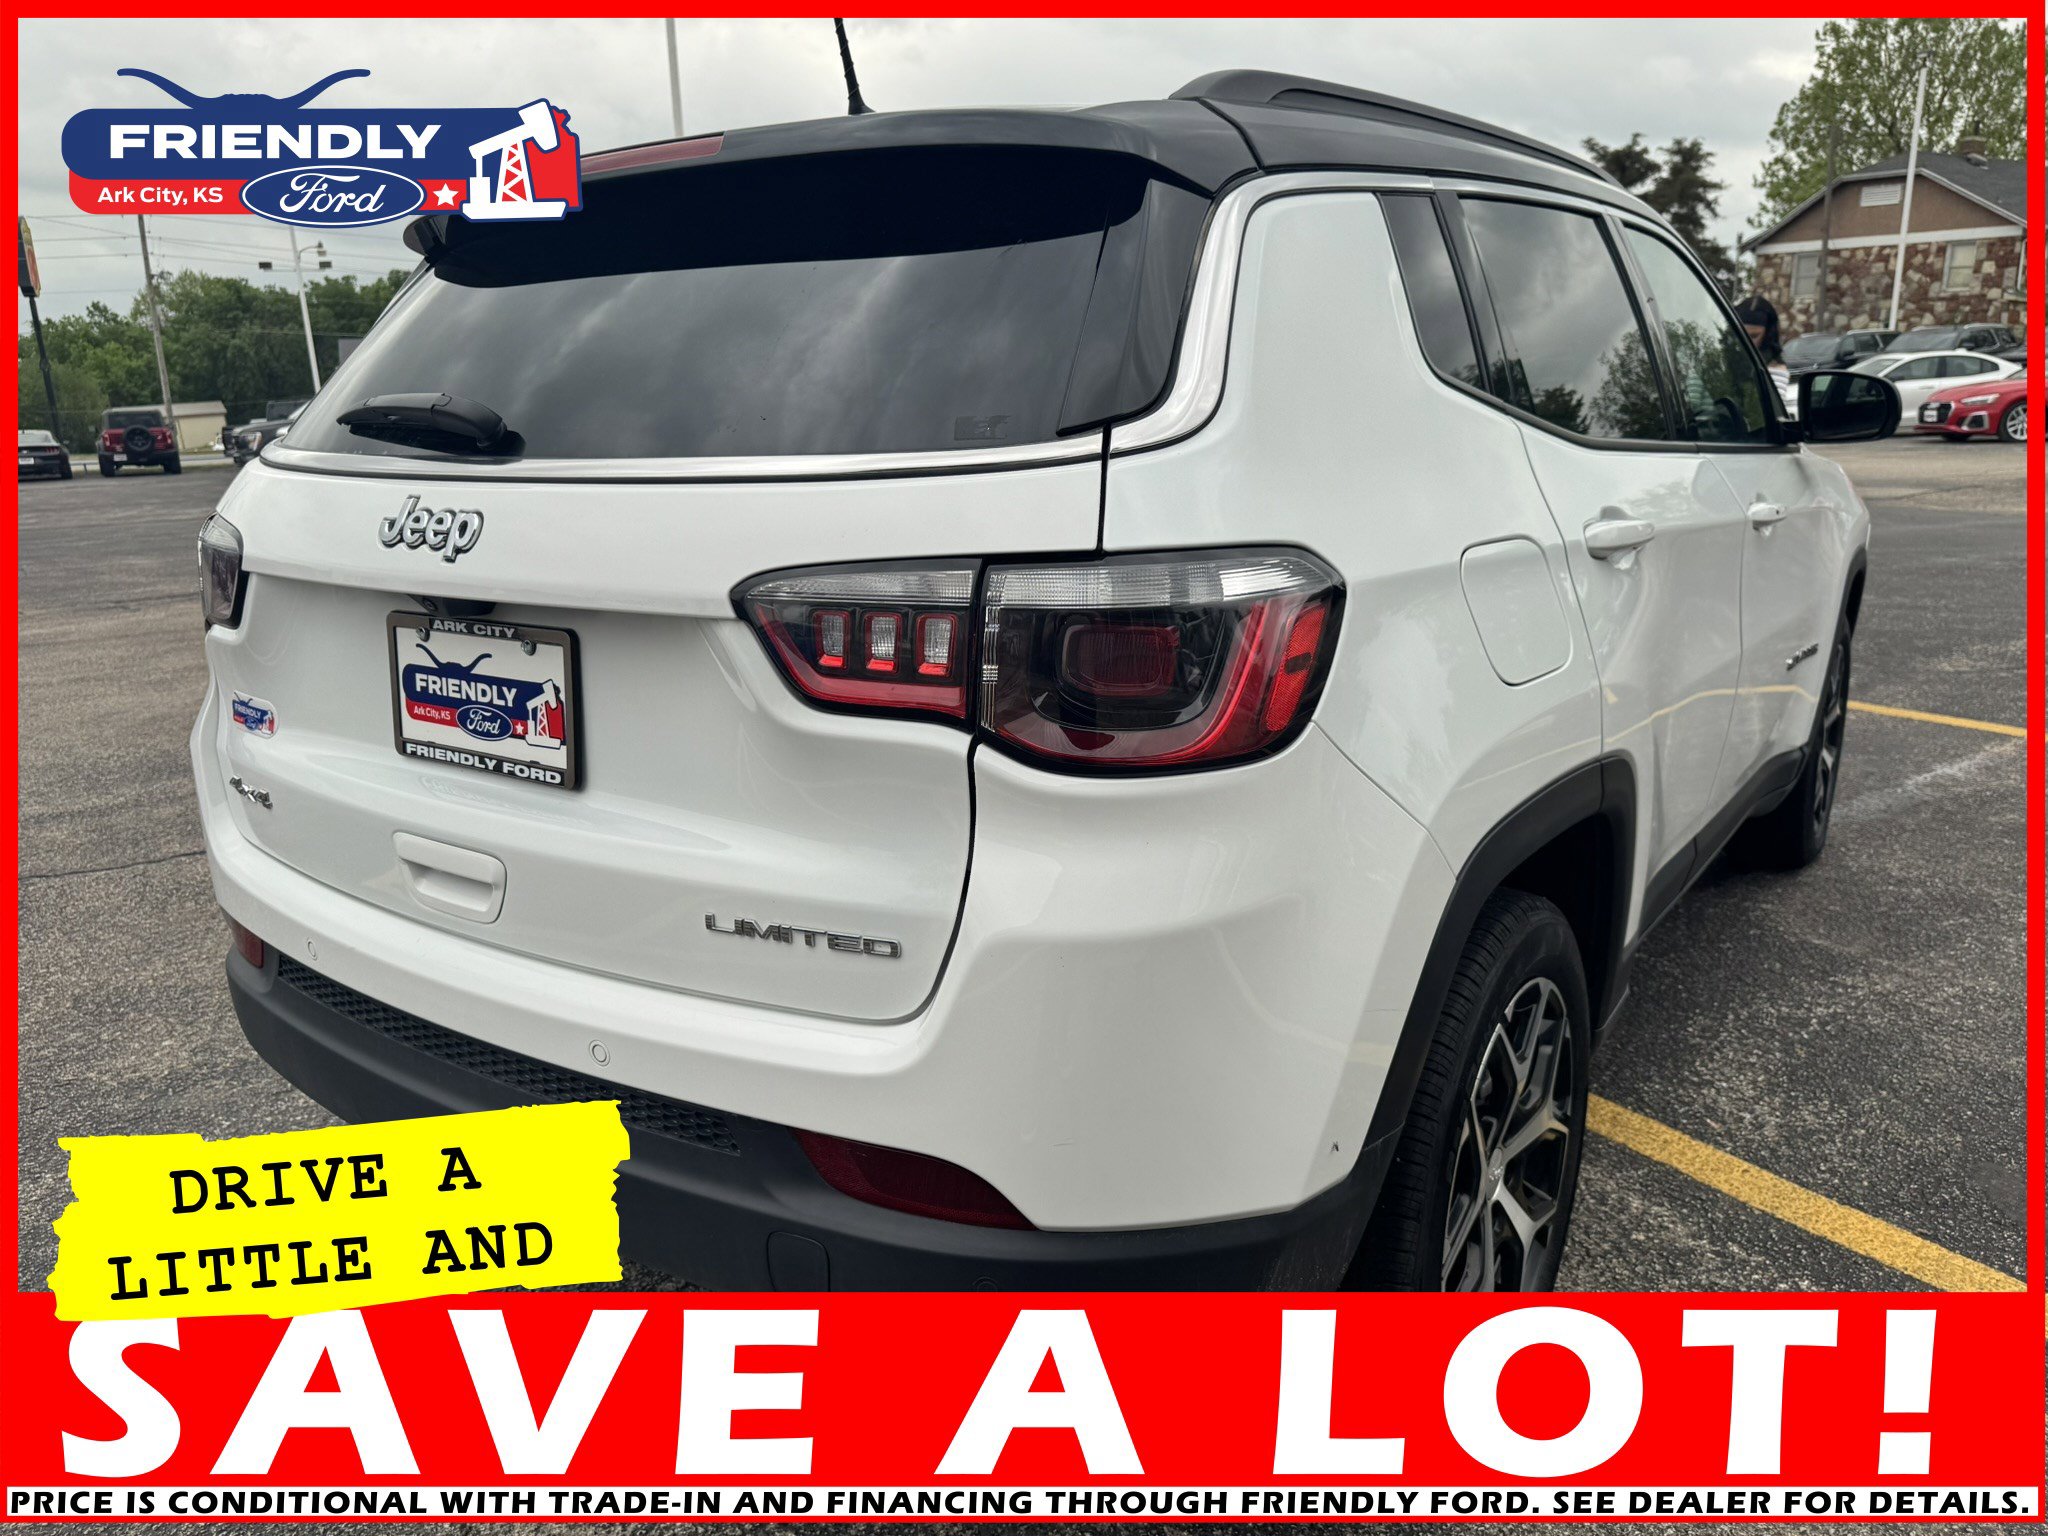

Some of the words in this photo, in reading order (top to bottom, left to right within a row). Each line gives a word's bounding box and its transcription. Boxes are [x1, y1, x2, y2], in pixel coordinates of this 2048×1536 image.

[379, 495, 484, 562] Jeep
[432, 619, 469, 633] ARK
[473, 625, 516, 638] CITY
[415, 673, 517, 706] FRIENDLY
[413, 706, 426, 715] Ark
[426, 707, 440, 719] City,
[440, 710, 451, 720] KS
[466, 709, 500, 734] Ford
[406, 743, 498, 770] FRIENDLY
[503, 762, 562, 784] FORD
[704, 911, 902, 959] LIMITED
